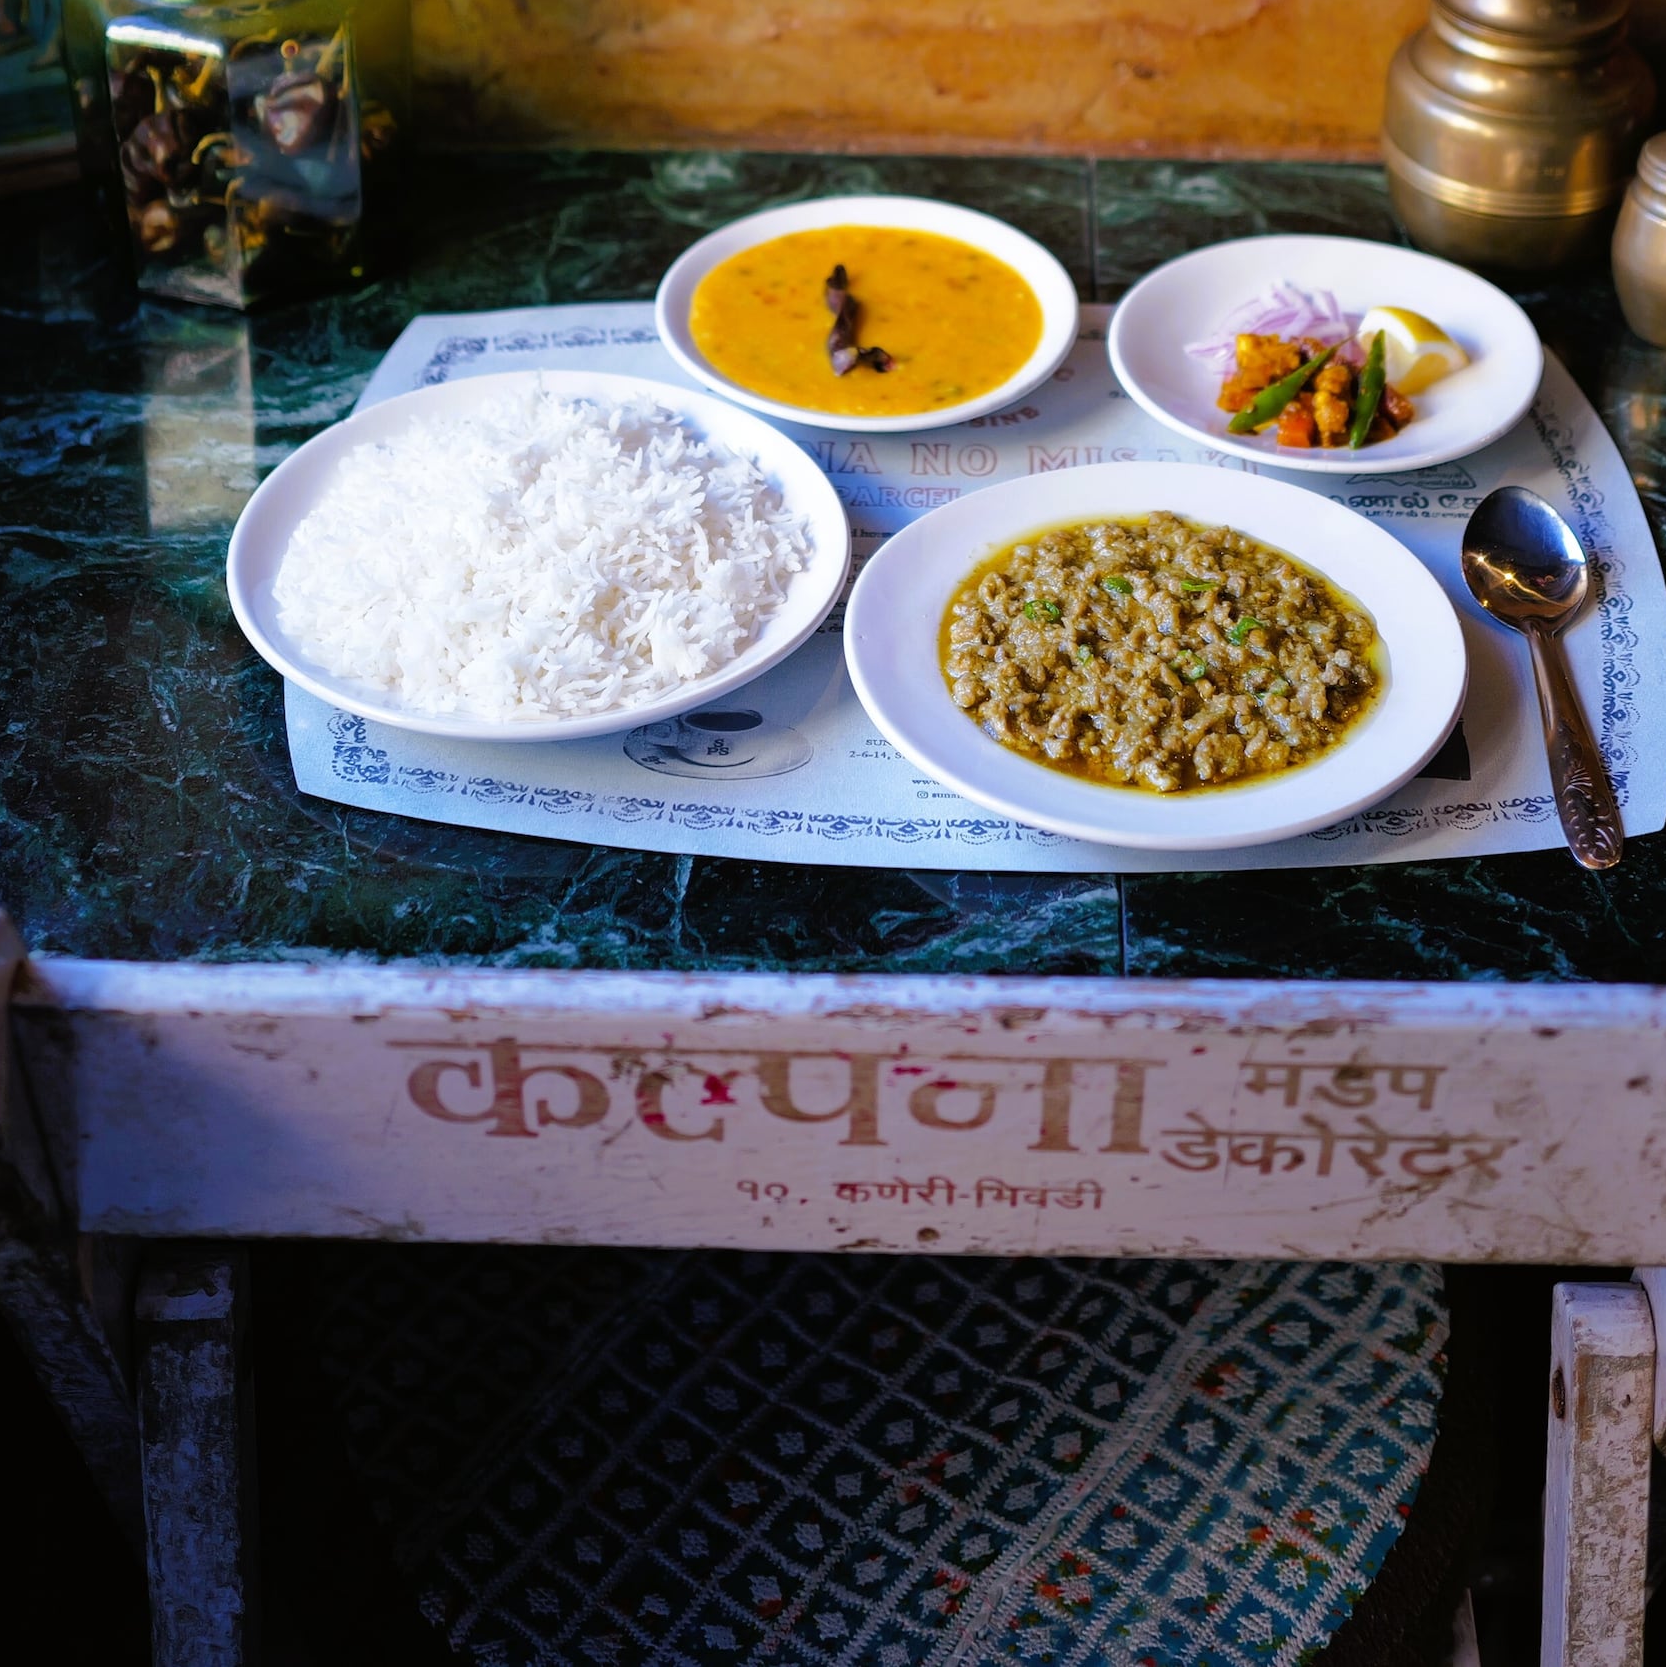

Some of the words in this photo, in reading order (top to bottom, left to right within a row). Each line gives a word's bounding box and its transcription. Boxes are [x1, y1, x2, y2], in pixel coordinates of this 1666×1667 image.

[910, 443, 997, 476] NO
[713, 739, 724, 748] S
[707, 747, 729, 756] PS
[849, 751, 891, 760] 2-6-14,
[1239, 1047, 1448, 1112] मंडप
